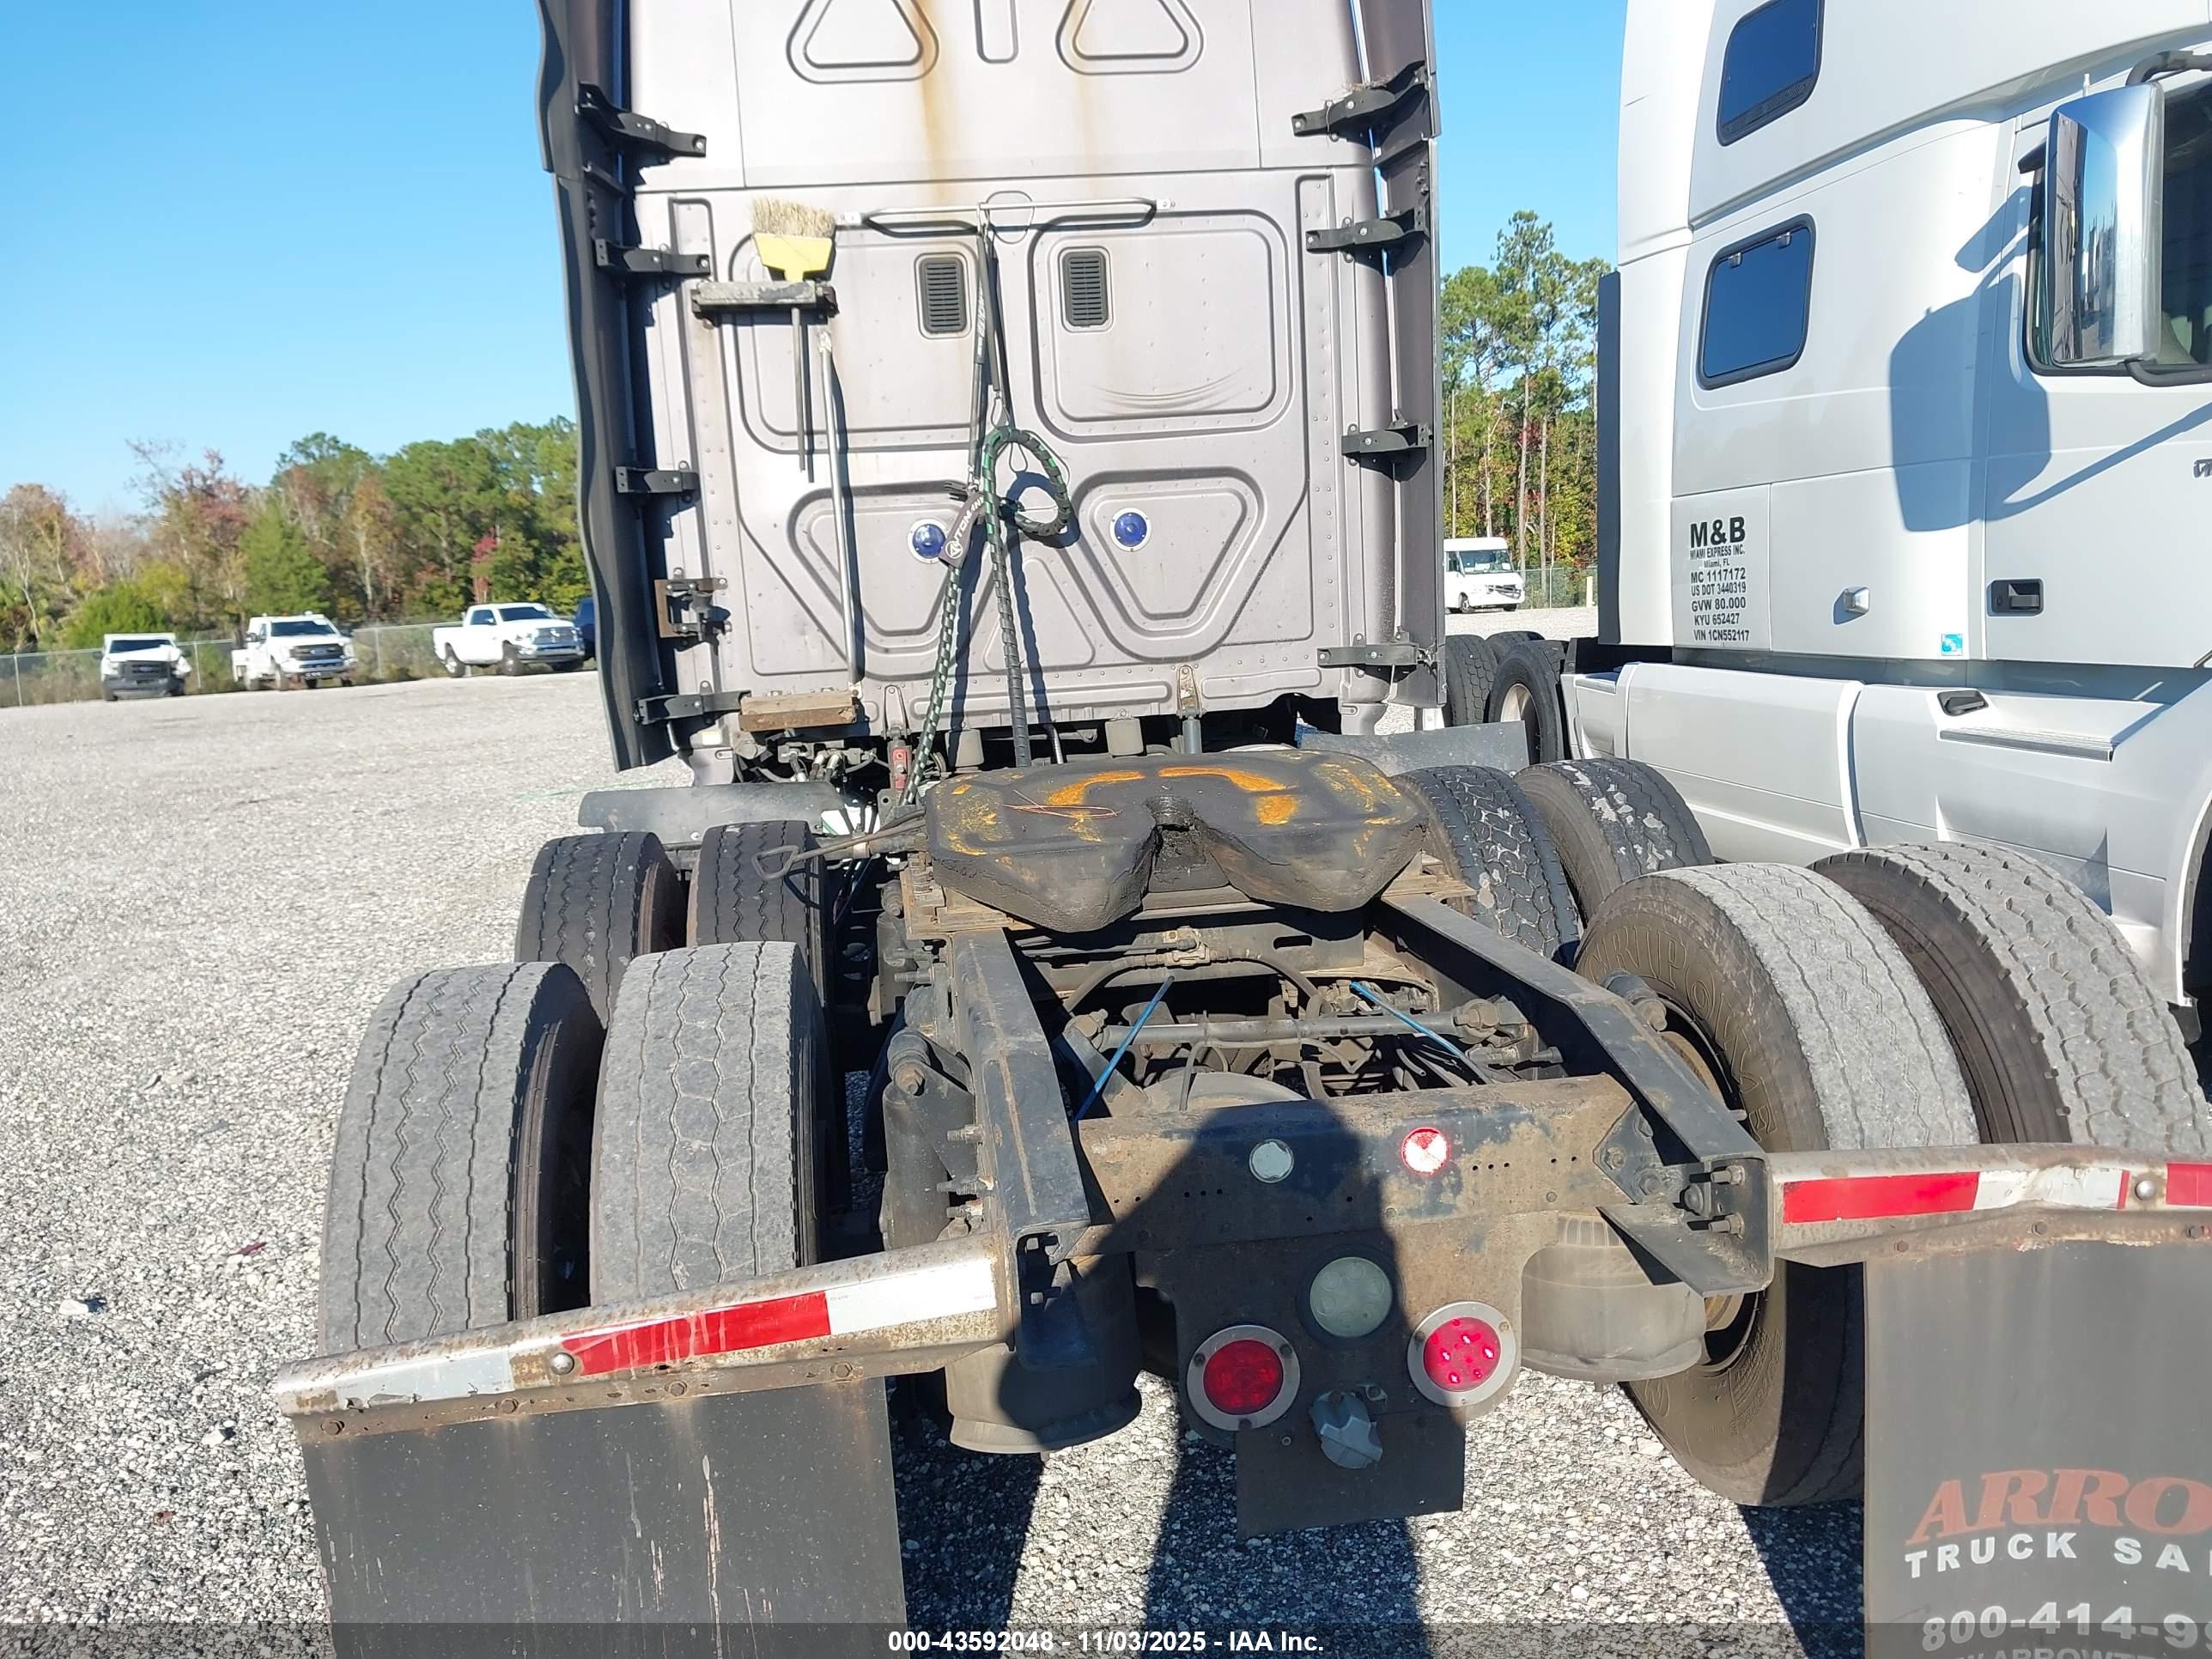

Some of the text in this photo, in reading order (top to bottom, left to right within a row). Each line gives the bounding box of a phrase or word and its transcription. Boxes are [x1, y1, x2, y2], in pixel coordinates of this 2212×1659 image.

[1690, 516, 1746, 549] M&B
[1706, 545, 1732, 558] EXPRESS
[1723, 558, 1729, 567] FL
[1691, 567, 1746, 584] MC 1117172
[1691, 581, 1747, 596] US DOT 3440319
[1692, 596, 1746, 612] GVW 80.000
[1694, 612, 1740, 626] KYU 652427
[1693, 629, 1749, 641] VIN 1CN552117
[1905, 1468, 2212, 1546] ARRO
[1905, 1532, 2212, 1579] TRUCK SA
[1922, 1601, 2212, 1652] 800-414-9
